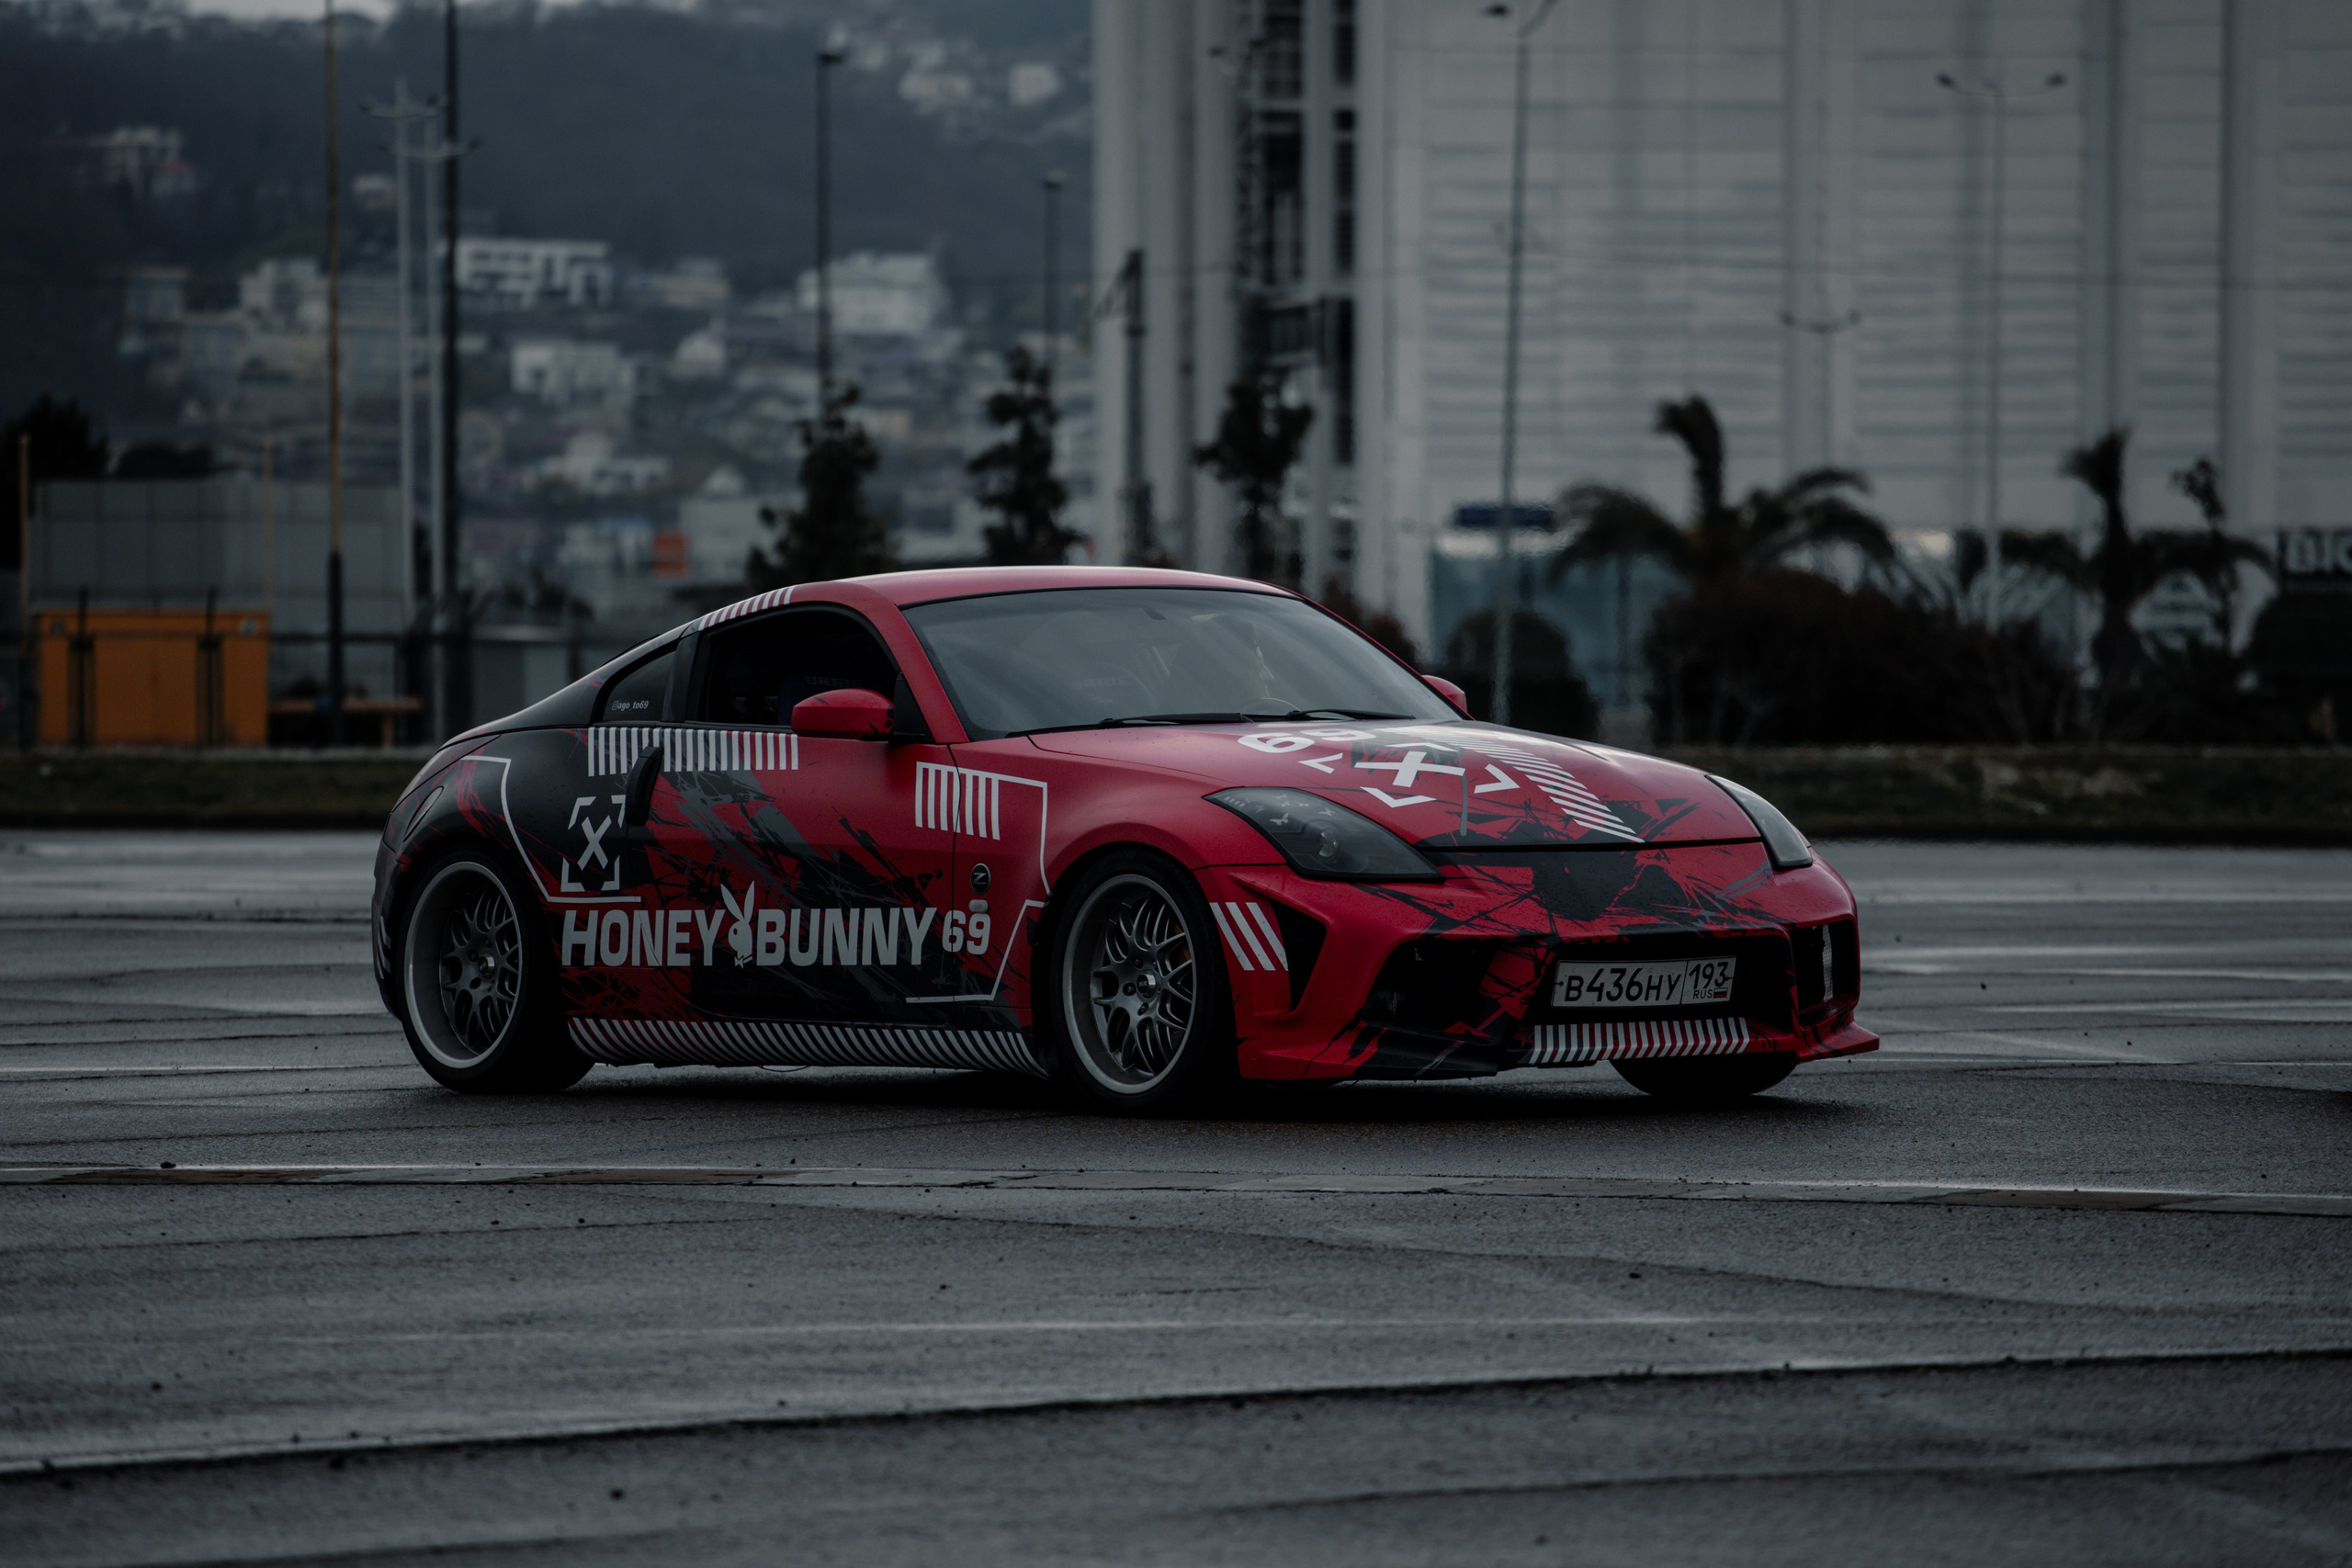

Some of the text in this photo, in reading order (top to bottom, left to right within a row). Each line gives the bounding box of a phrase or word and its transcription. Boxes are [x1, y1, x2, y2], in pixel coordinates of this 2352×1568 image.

[1237, 728, 1378, 754] 69
[561, 907, 991, 967] HONEY BUNNY 69
[1688, 961, 1729, 990] 193
[1692, 988, 1713, 999] RUS
